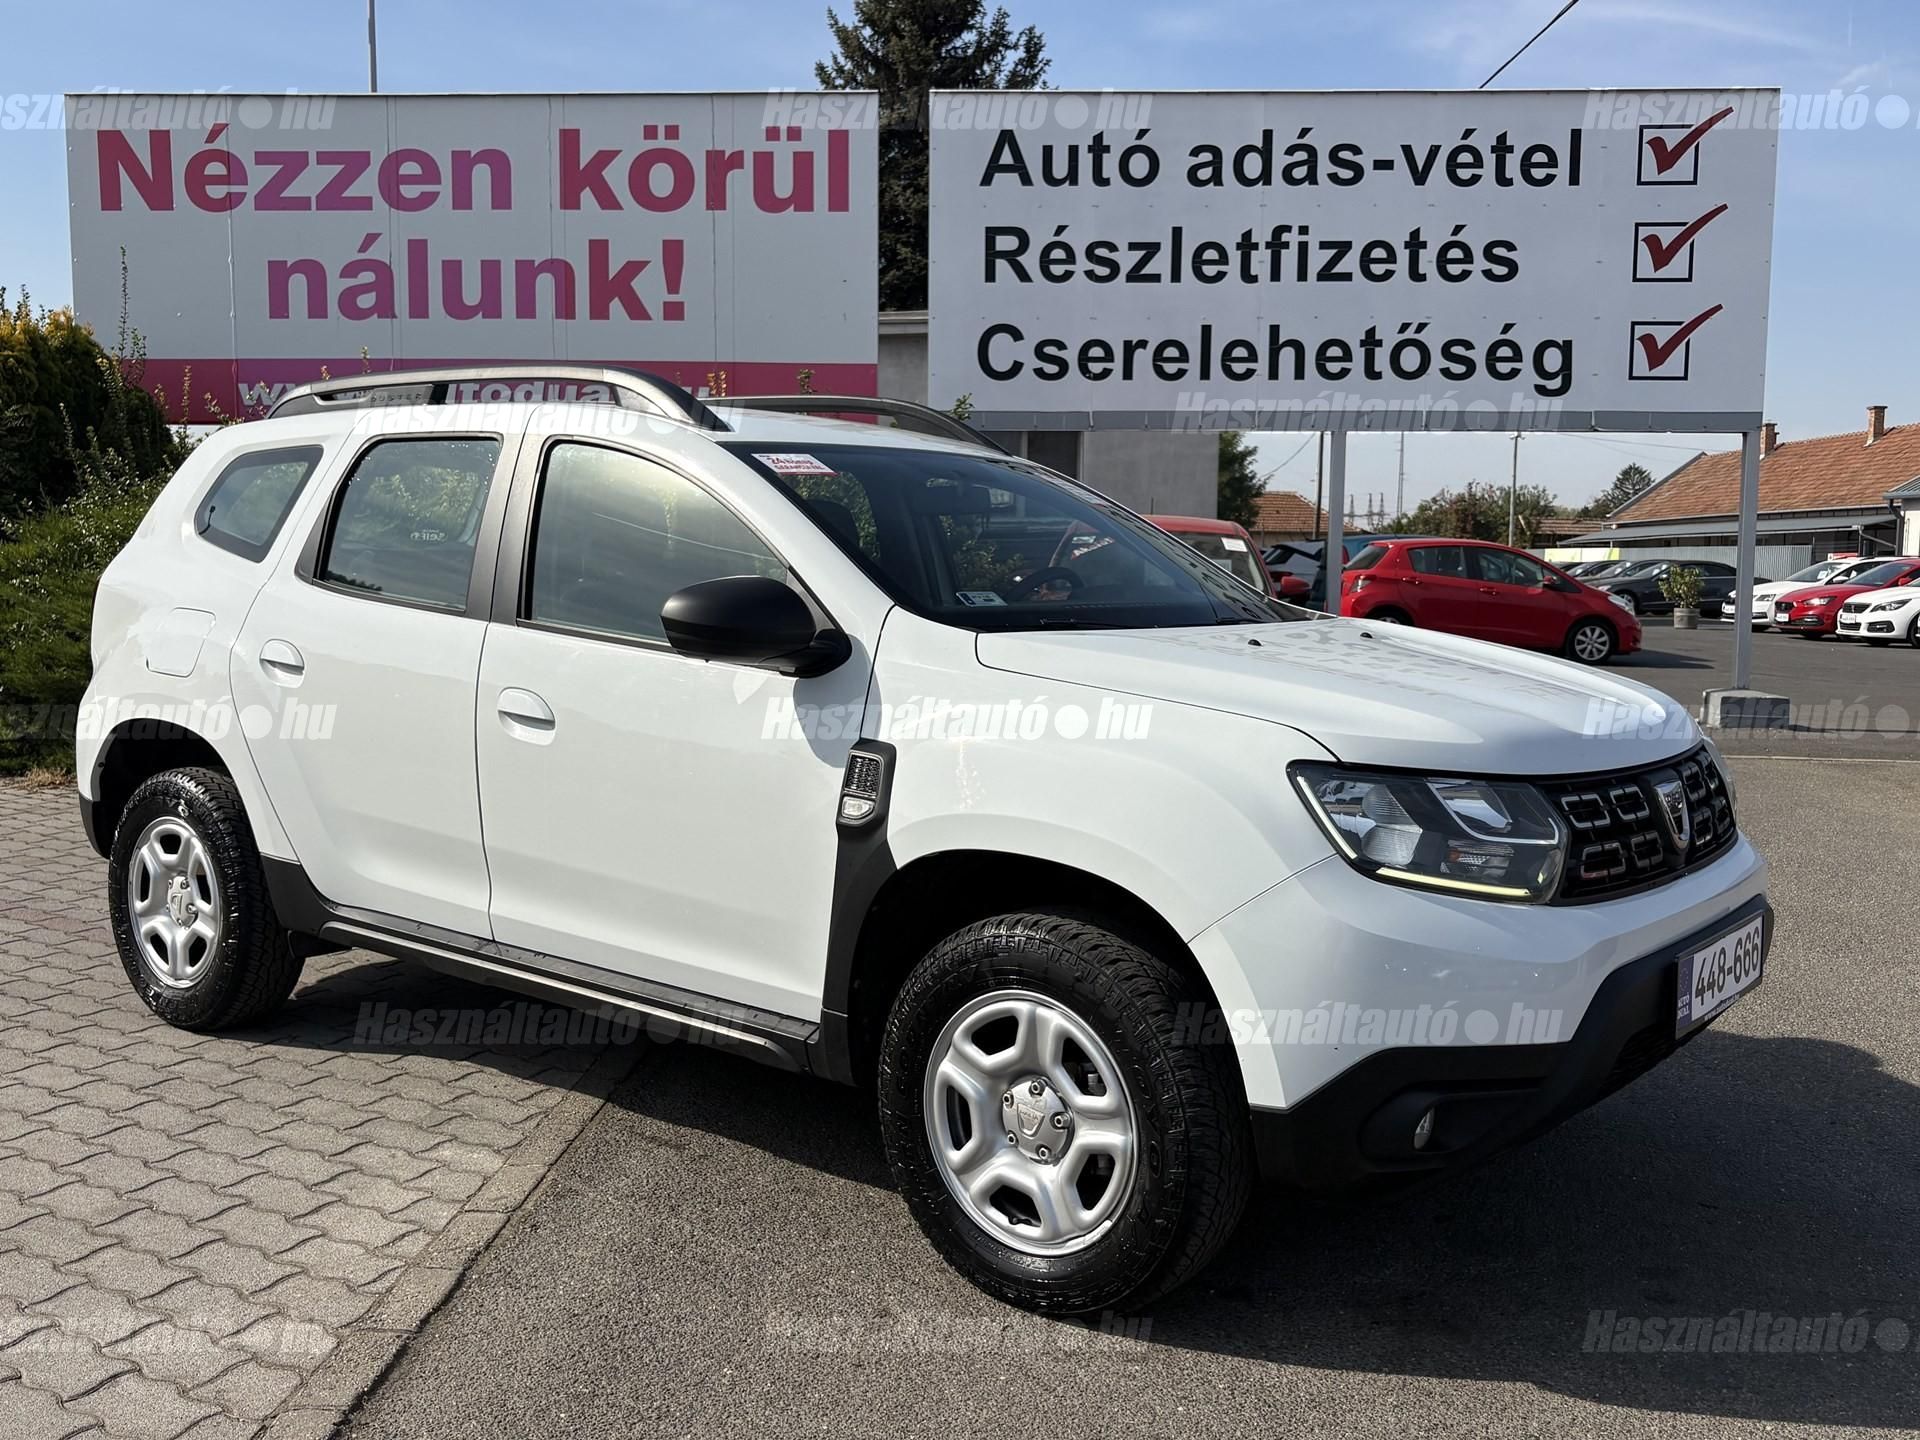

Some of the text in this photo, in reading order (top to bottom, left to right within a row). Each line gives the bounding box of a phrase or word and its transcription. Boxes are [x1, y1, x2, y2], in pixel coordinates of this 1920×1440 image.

[97, 123, 850, 213] Nézzen körül
[979, 128, 1583, 188] Autó adás-vétel
[267, 232, 686, 321] nálunk!
[985, 224, 1520, 284] Részletfizetés
[977, 322, 1574, 397] Cserelehetőség
[1695, 926, 1760, 1006] 448-666
